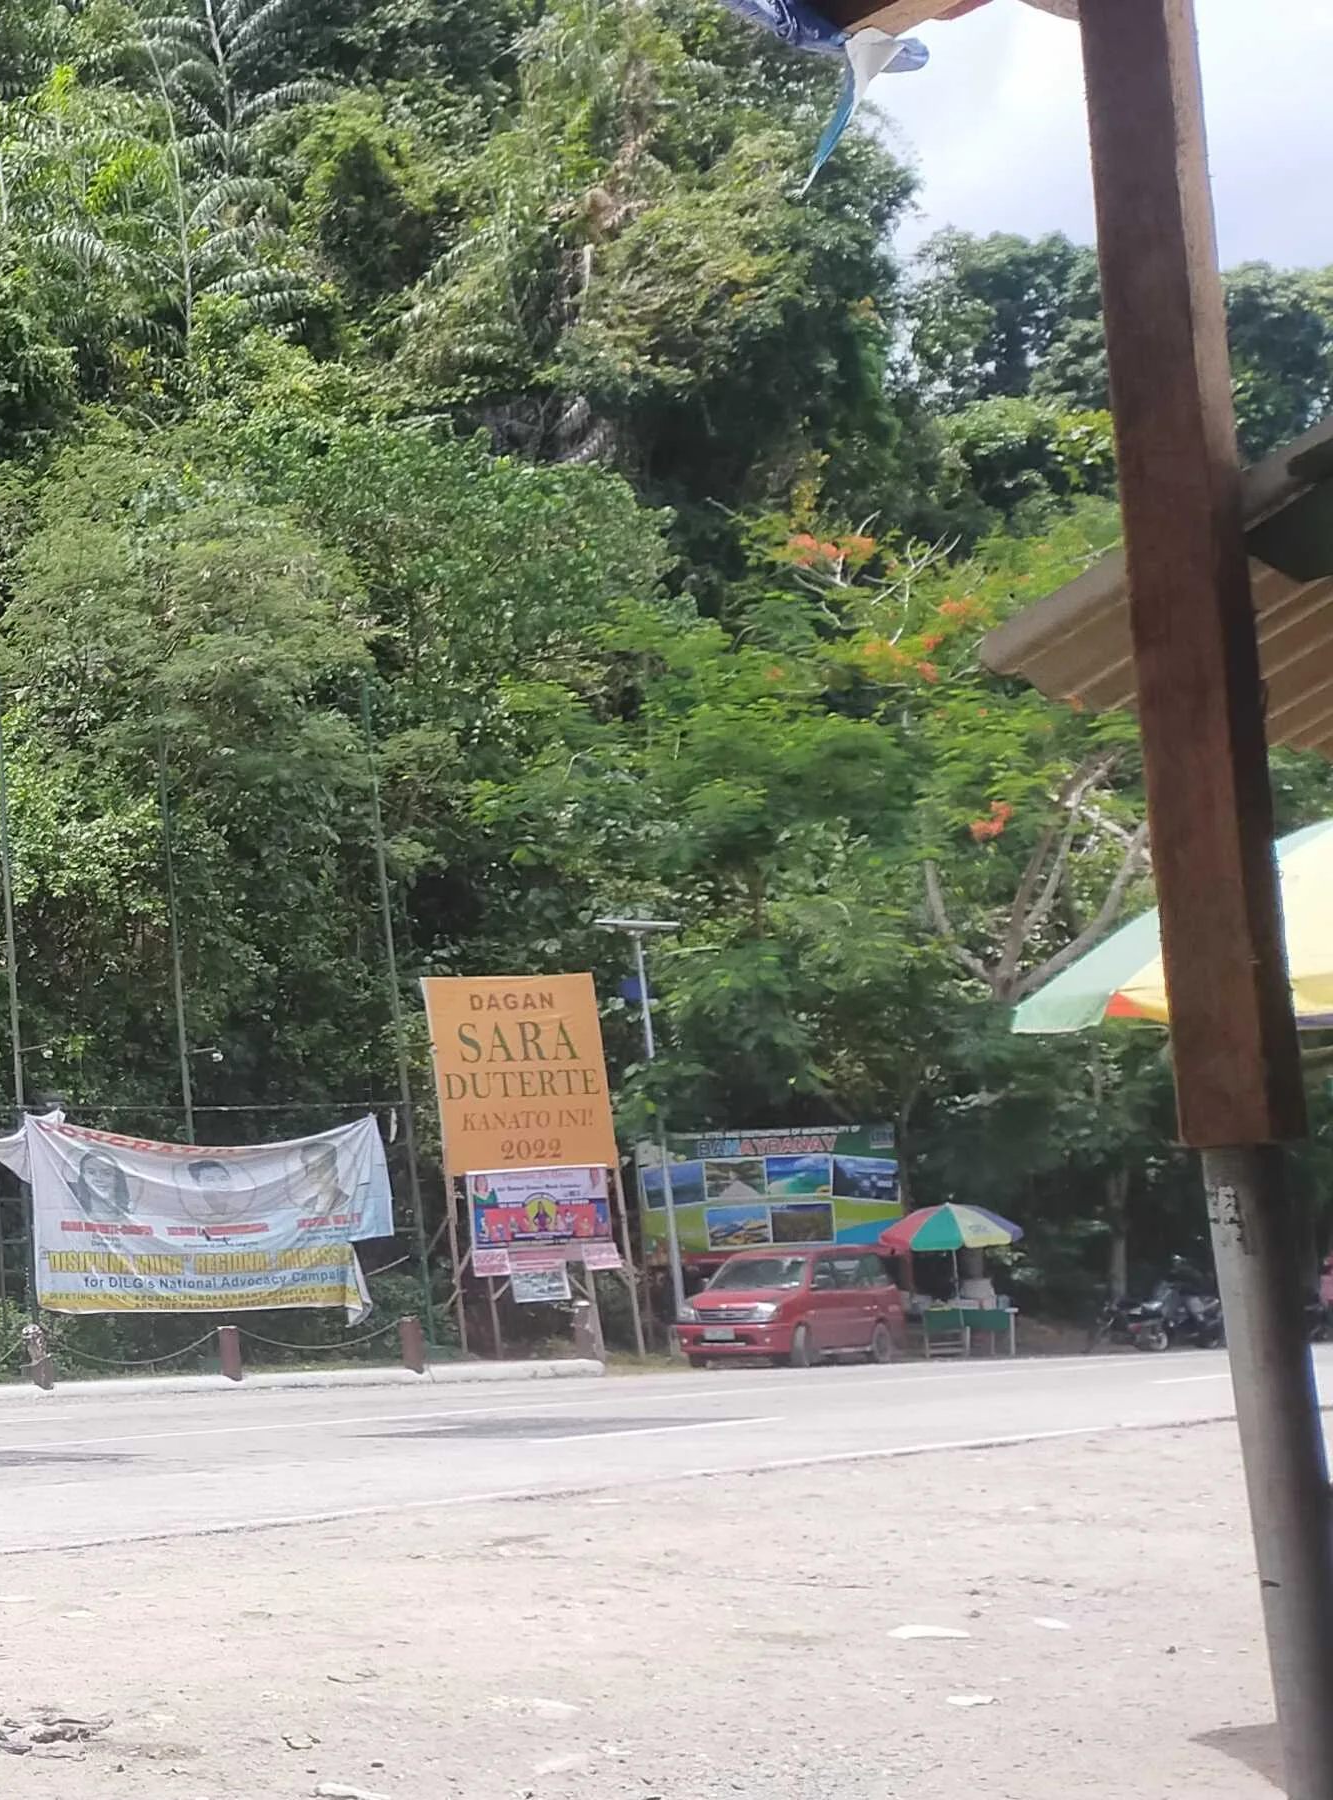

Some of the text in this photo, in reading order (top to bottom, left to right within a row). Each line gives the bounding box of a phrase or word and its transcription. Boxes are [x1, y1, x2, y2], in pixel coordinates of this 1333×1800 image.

[469, 992, 554, 1011] DAGAN
[457, 1018, 581, 1064] SARA
[445, 1068, 601, 1100] DUTERTE
[461, 1108, 594, 1132] KANATO INI!
[500, 1138, 563, 1160] 2022
[84, 1277, 105, 1288] for
[160, 1277, 217, 1289] National
[221, 1276, 287, 1289] Advocacy
